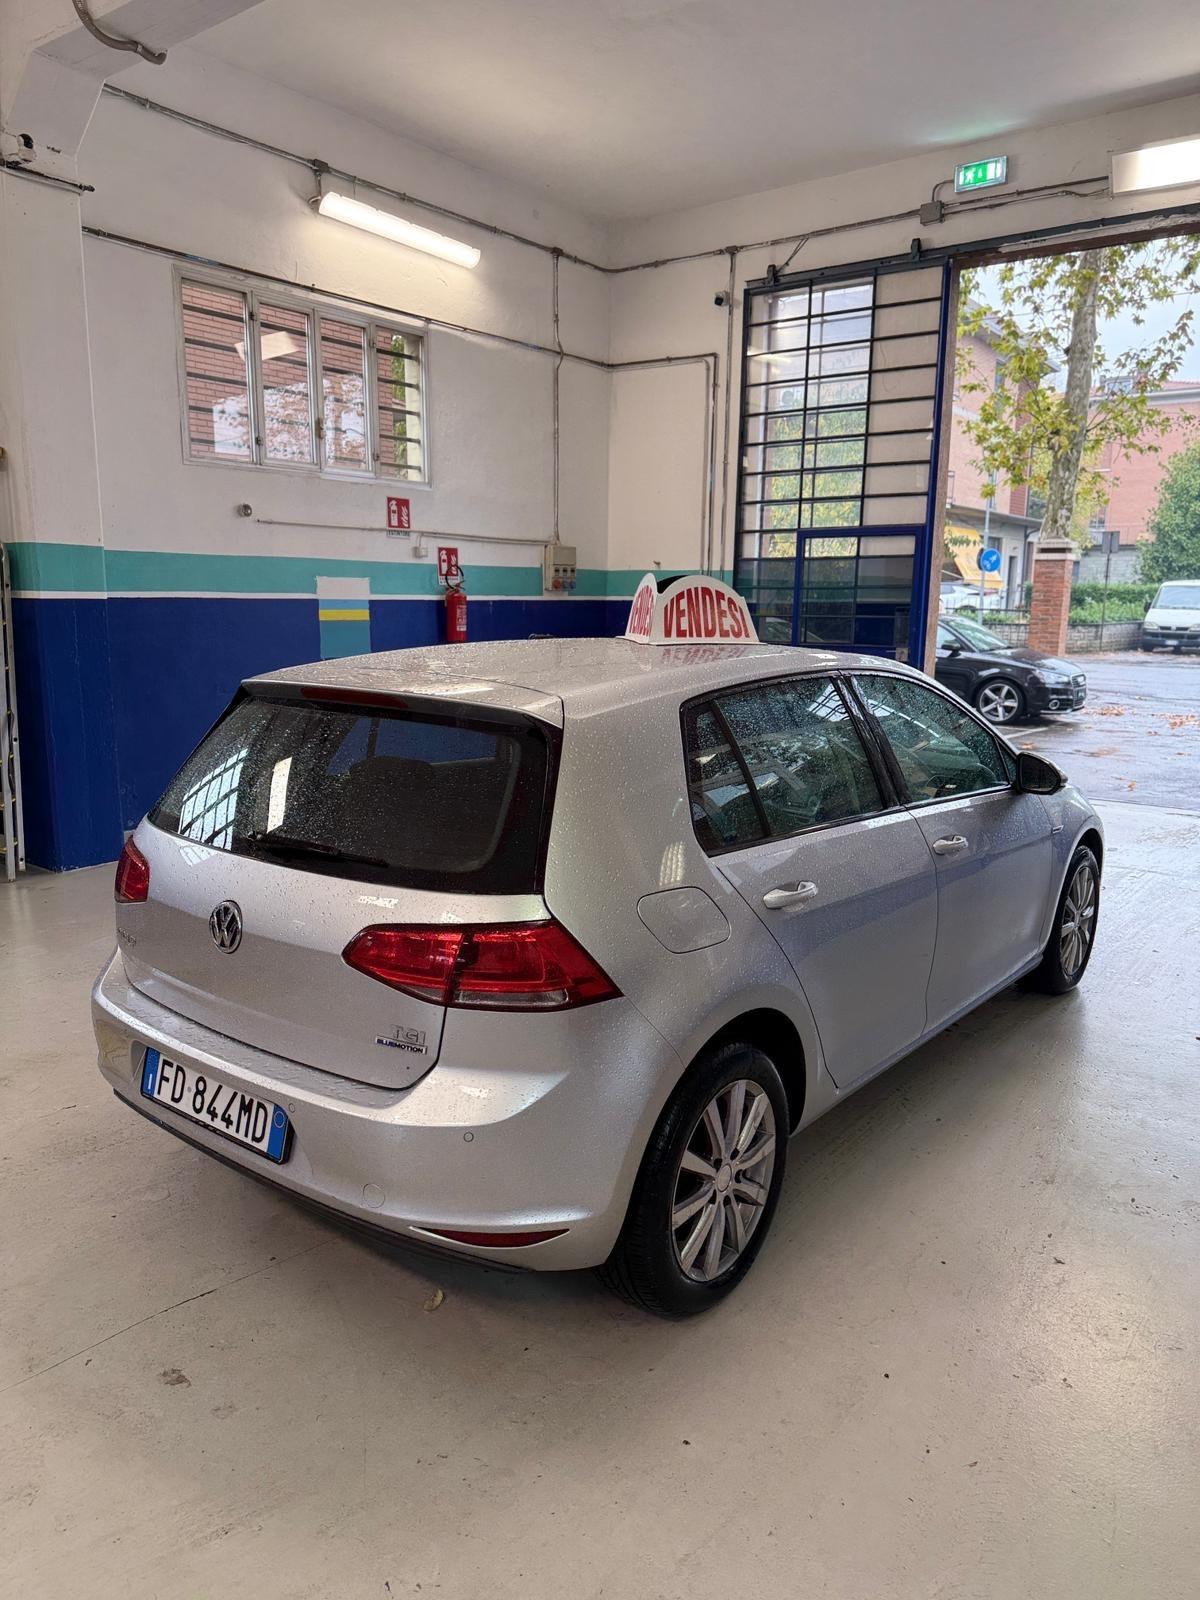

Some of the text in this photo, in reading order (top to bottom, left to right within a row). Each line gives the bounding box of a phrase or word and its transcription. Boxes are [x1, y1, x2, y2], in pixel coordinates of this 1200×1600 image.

[664, 587, 750, 638] VENDESI
[157, 1058, 268, 1143] FD 844MD
